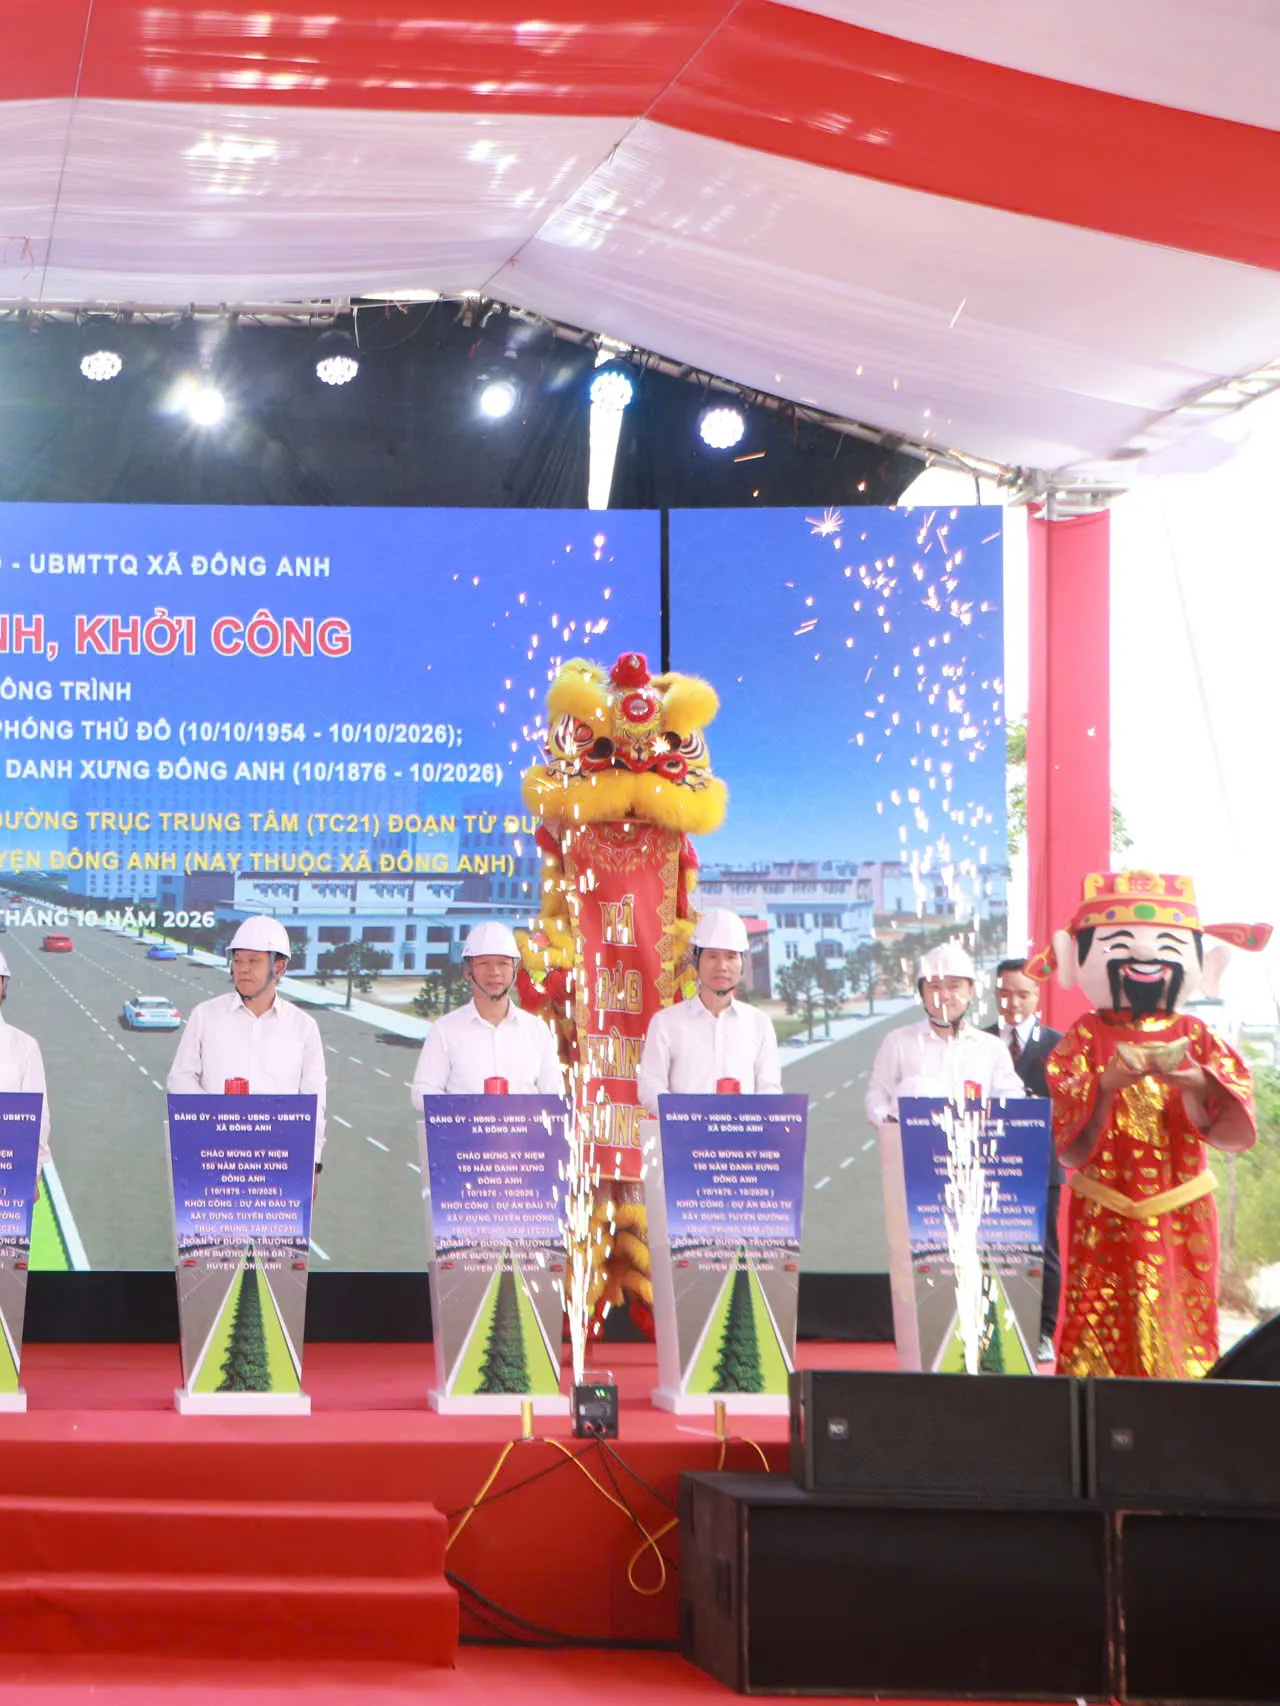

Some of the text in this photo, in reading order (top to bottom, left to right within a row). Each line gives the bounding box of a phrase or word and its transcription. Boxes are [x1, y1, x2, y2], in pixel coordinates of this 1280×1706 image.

[30, 552, 138, 577] UBMTTQ
[147, 551, 183, 576] XÃ
[191, 552, 267, 577] ĐÔNG
[276, 556, 330, 577] ANH
[75, 607, 196, 655] KHỞI
[211, 609, 352, 657] CÔNG
[59, 677, 131, 701] TRÌNH
[81, 717, 129, 741] THỦ
[135, 717, 171, 741] ĐÔ
[179, 721, 306, 745] (10/10/1954
[329, 722, 462, 748] 10/10/2026);
[6, 758, 73, 779] DANH
[80, 758, 150, 780] XƯNG
[157, 756, 228, 781] ĐÔNG
[234, 761, 285, 781] ANH
[293, 761, 386, 785] (10/1876
[410, 762, 504, 786] 10/2026)
[87, 811, 150, 835] TRỤC
[159, 812, 241, 832] TRUNG
[249, 809, 299, 832] TÂM
[306, 813, 381, 836] (TC21)
[387, 814, 456, 837] ĐOẠN
[464, 812, 498, 834] TỪ
[48, 847, 120, 871] ĐÔNG
[126, 852, 177, 871] ANH
[184, 852, 242, 876] (NAY
[249, 850, 332, 877] THUỘC
[340, 849, 373, 873] XÃ
[378, 849, 449, 873] ĐÔNG
[456, 855, 516, 878] ANH)
[78, 911, 99, 927] 10
[105, 906, 157, 928] NĂM
[163, 911, 215, 928] 2026
